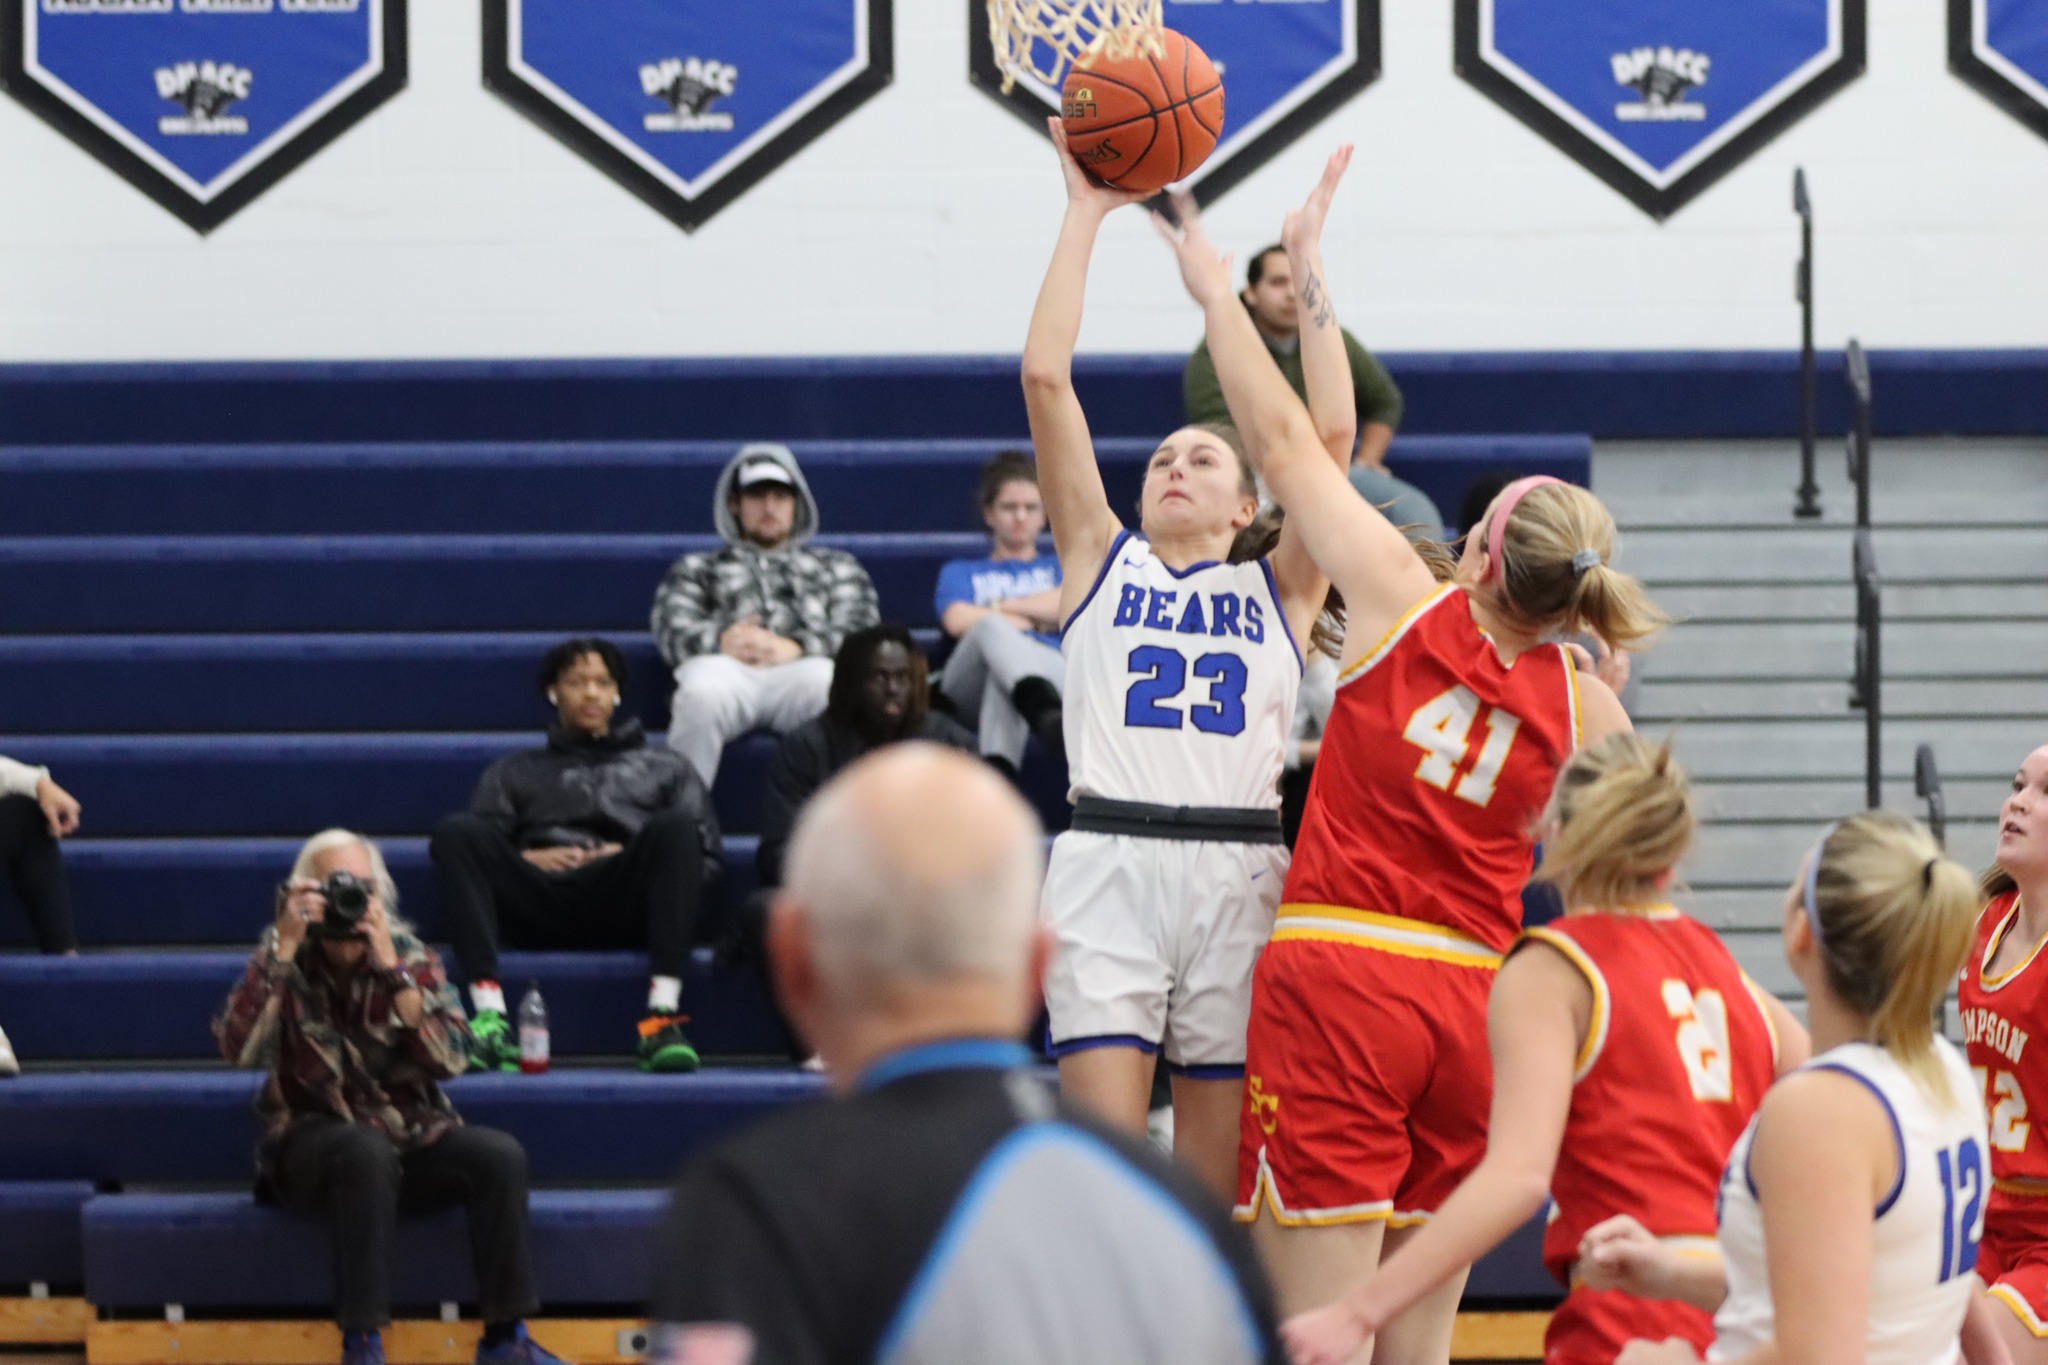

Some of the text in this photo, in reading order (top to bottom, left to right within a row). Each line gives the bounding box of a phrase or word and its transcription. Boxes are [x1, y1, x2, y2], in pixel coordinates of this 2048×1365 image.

[1113, 582, 1265, 645] BEARS
[1124, 644, 1248, 737] 23
[1402, 683, 1522, 808] 41
[1249, 1074, 1279, 1136] SC
[1936, 1137, 1983, 1284] 12
